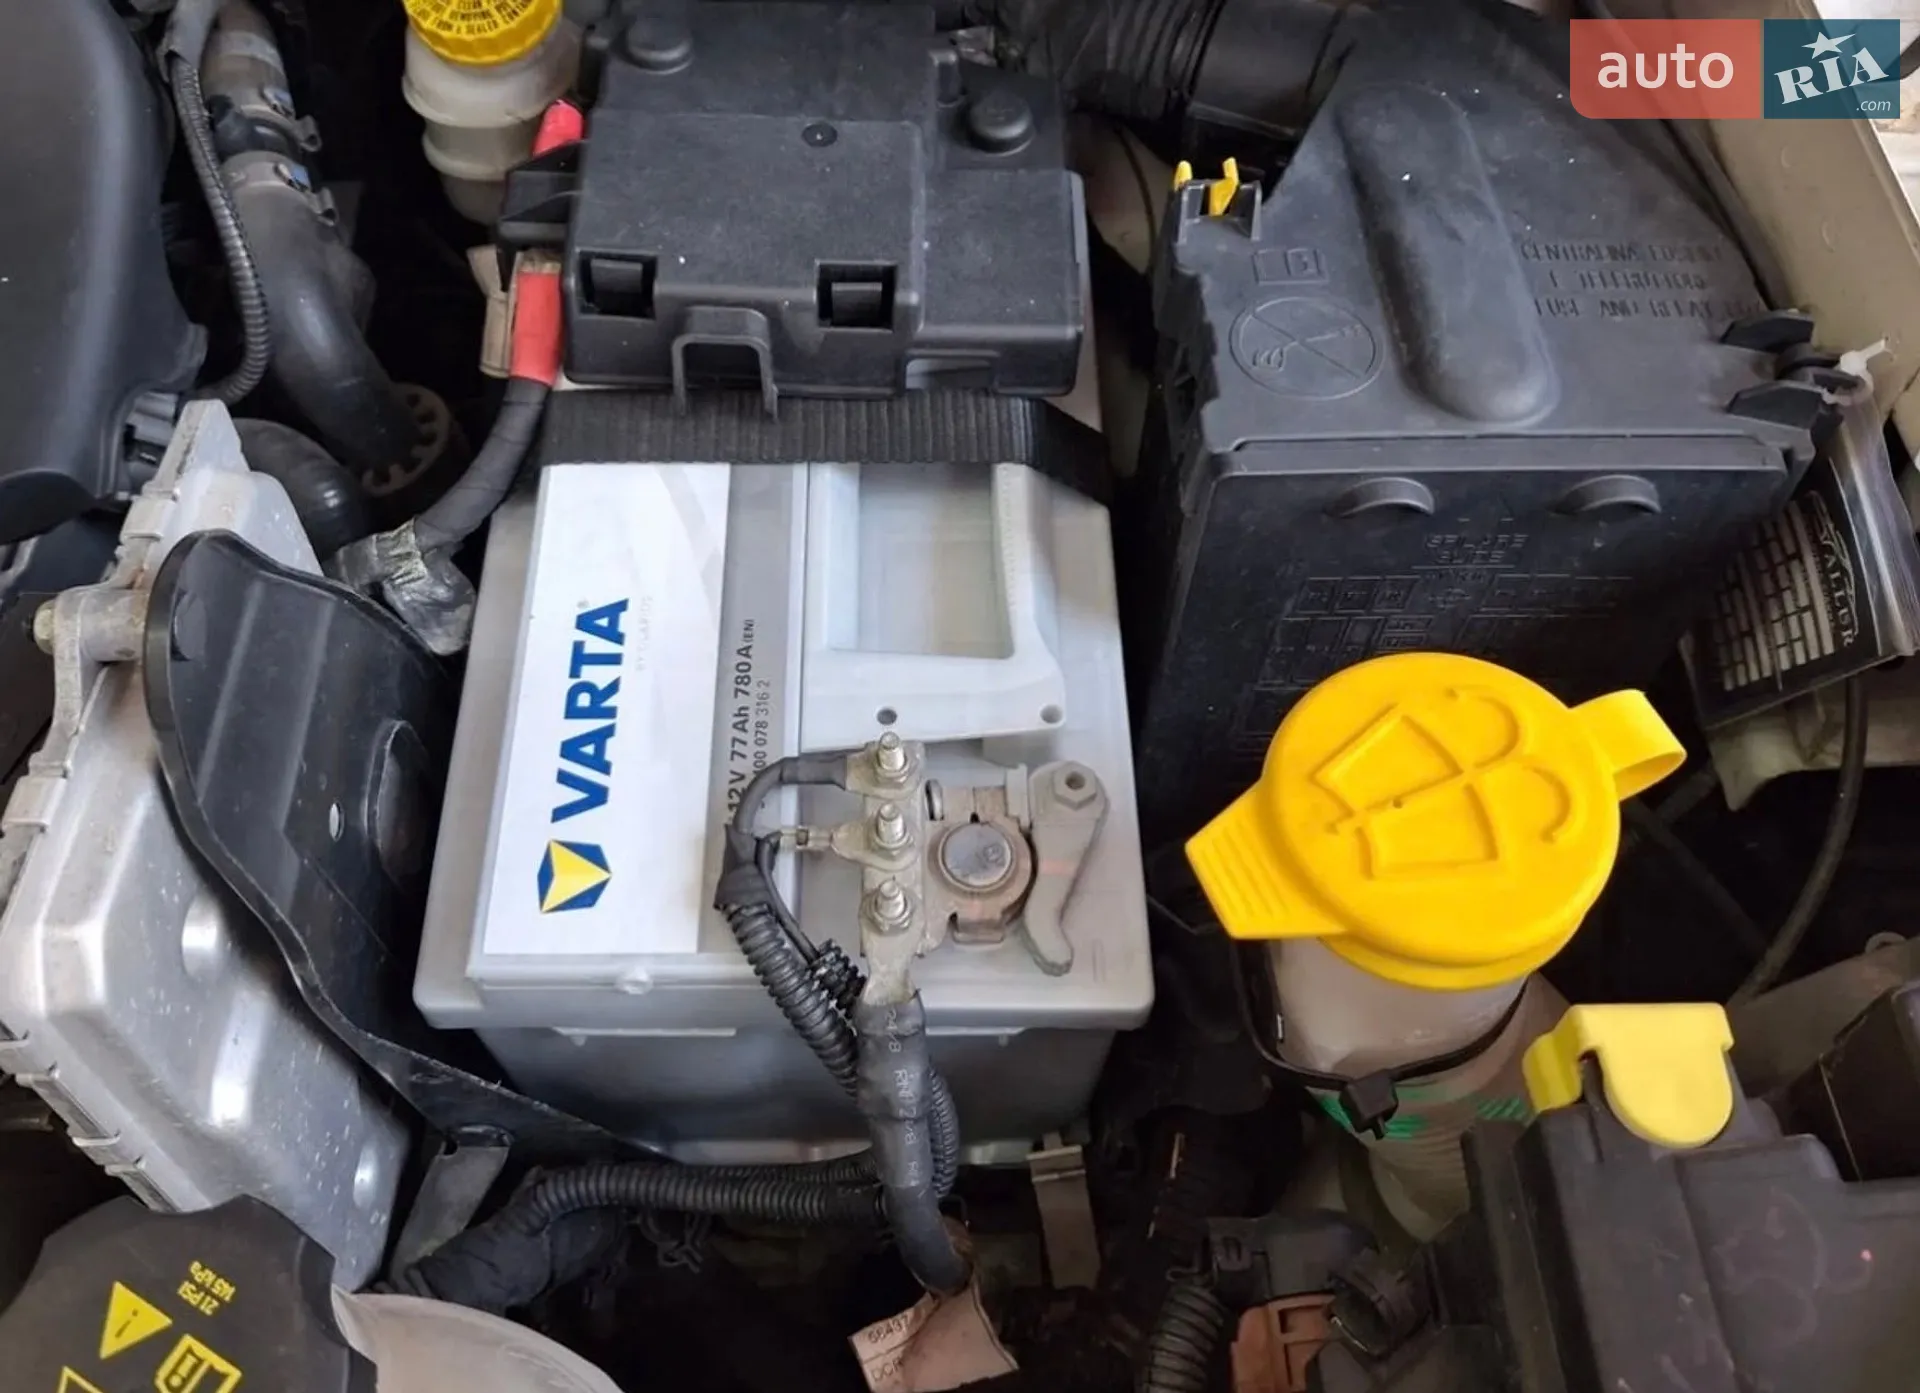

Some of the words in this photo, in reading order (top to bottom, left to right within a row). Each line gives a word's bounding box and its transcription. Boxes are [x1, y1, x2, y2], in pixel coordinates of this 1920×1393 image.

[757, 679, 771, 689] 2
[550, 597, 630, 824] VARTA
[755, 691, 771, 717] 316
[753, 721, 769, 748] 078
[177, 1281, 205, 1307] PSI
[199, 1295, 219, 1316] 21
